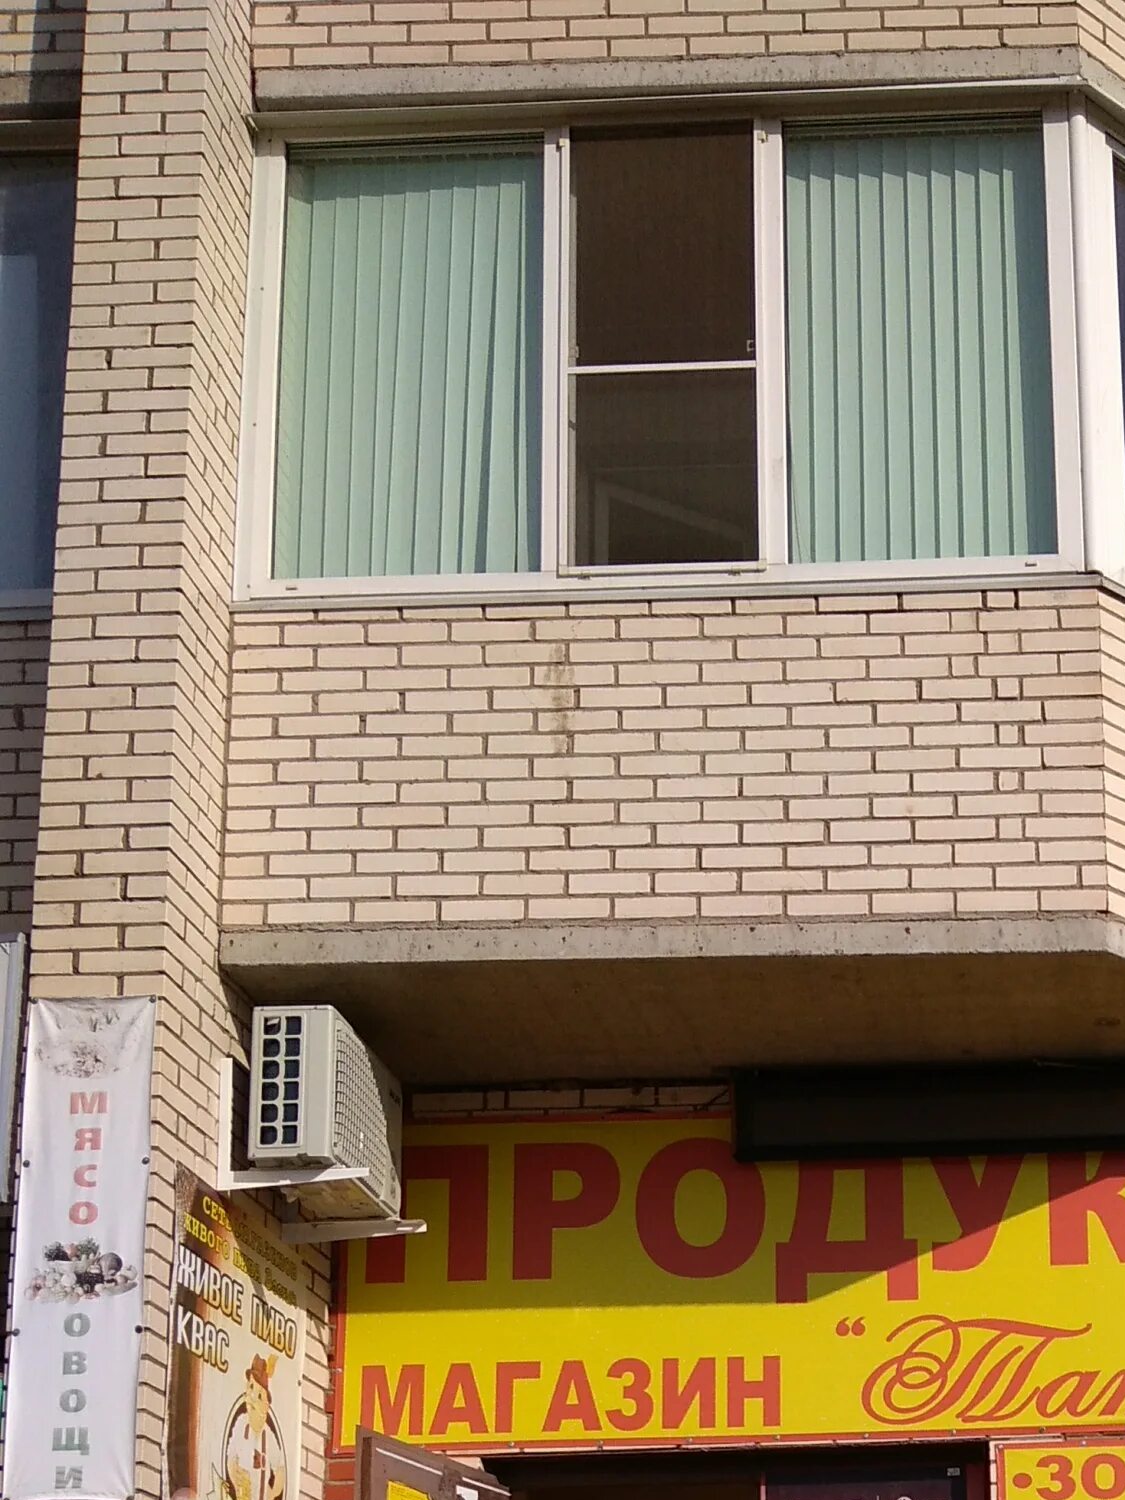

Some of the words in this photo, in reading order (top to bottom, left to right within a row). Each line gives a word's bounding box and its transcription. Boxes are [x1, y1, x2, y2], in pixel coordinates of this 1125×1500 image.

[69, 1091, 108, 1225] МЯСО
[184, 1211, 230, 1260] ЖИВОГО
[202, 1195, 233, 1232] СЕТЬ
[176, 1244, 244, 1326] ЖИВОЕ
[251, 1293, 297, 1359] ПИВО
[176, 1304, 230, 1373] КВАС
[52, 1312, 91, 1489] ОВОЩИ
[361, 1355, 782, 1436] МАГАЗИН
